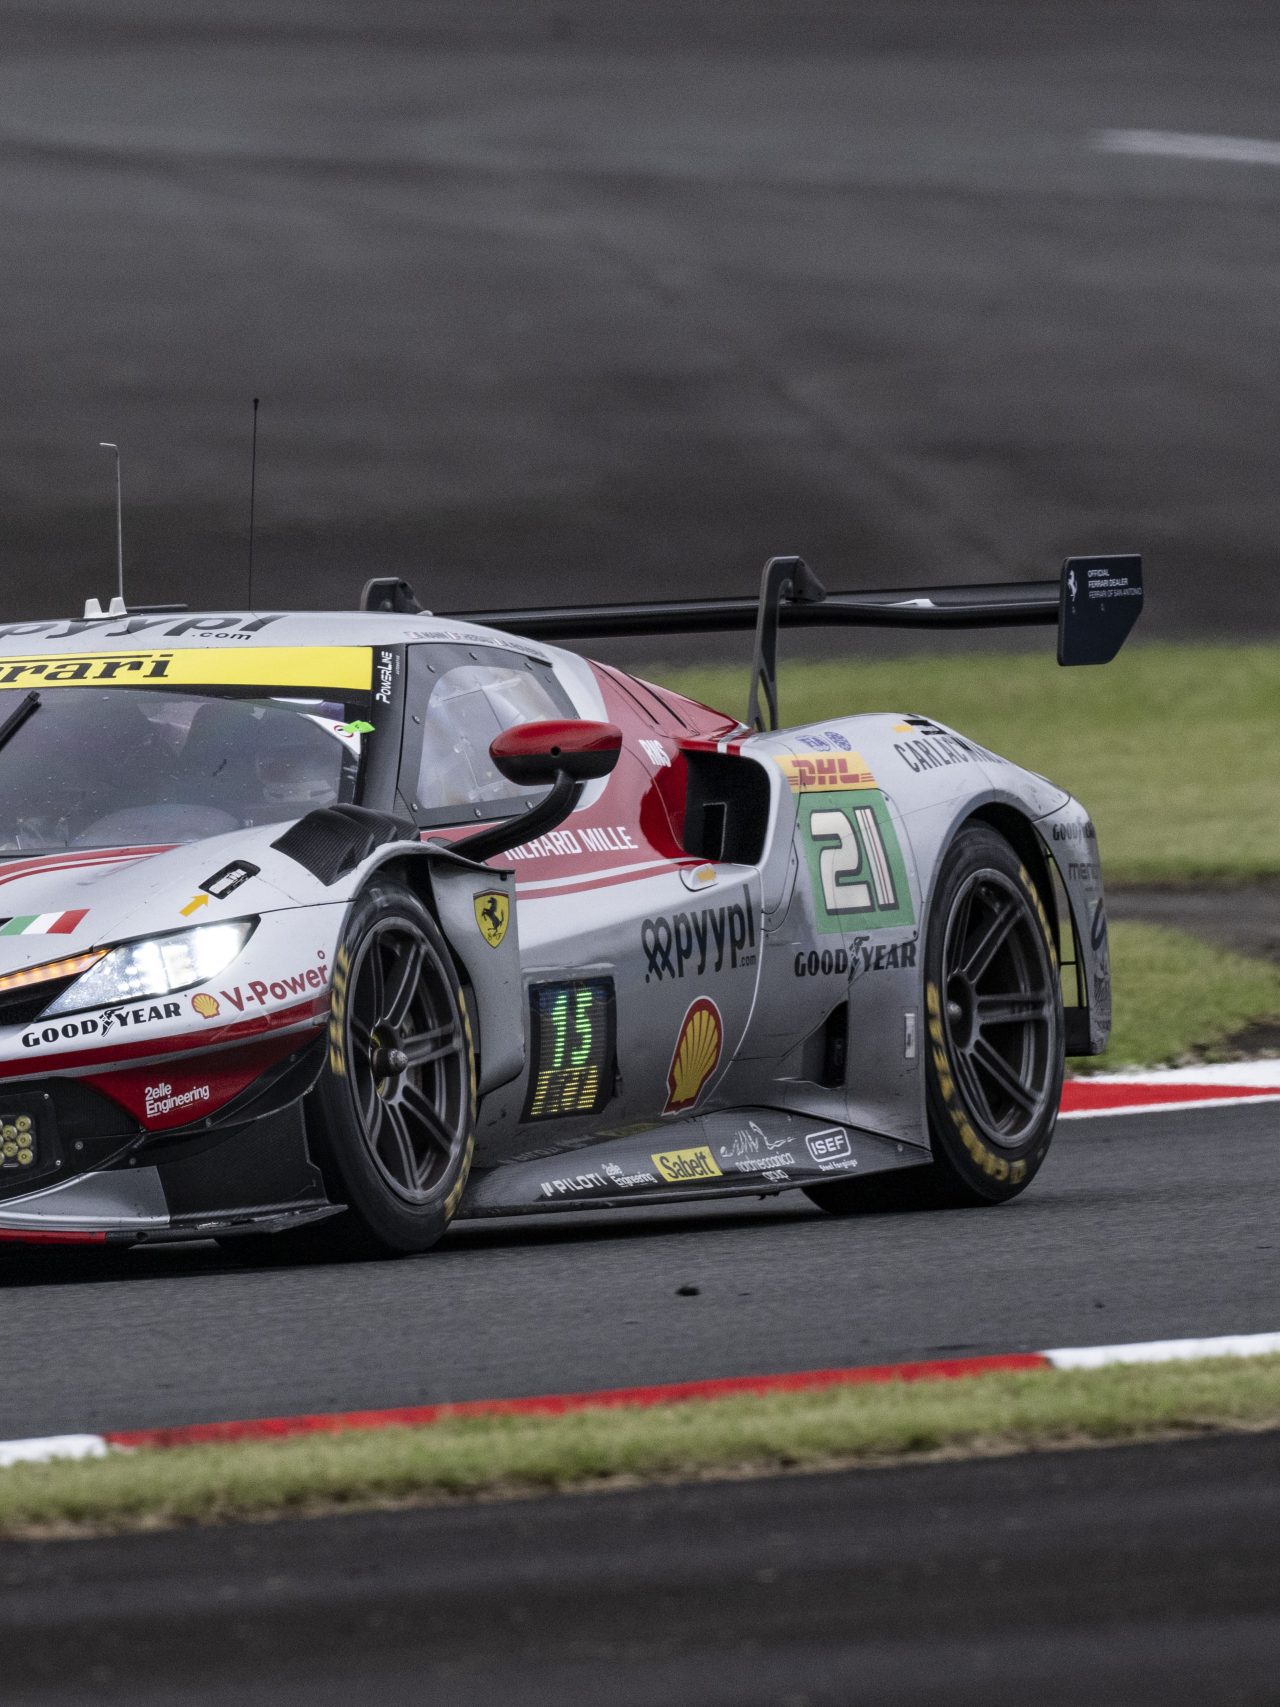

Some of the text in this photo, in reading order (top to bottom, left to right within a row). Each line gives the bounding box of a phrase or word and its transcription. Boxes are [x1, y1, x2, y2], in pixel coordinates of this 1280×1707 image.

[792, 758, 860, 785] DHL
[578, 826, 639, 853] MILLE
[810, 805, 899, 916] 21
[673, 884, 755, 977] pyypl
[794, 942, 916, 978] GOODYEAR
[220, 964, 330, 1012] V-Power
[22, 1003, 181, 1048] GOODYEAR
[145, 1083, 172, 1101] 2elle
[146, 1085, 210, 1114] Engineering
[810, 1135, 845, 1156] ISEF
[659, 1151, 715, 1179] Sabelt
[551, 1172, 608, 1194] PILOTI
